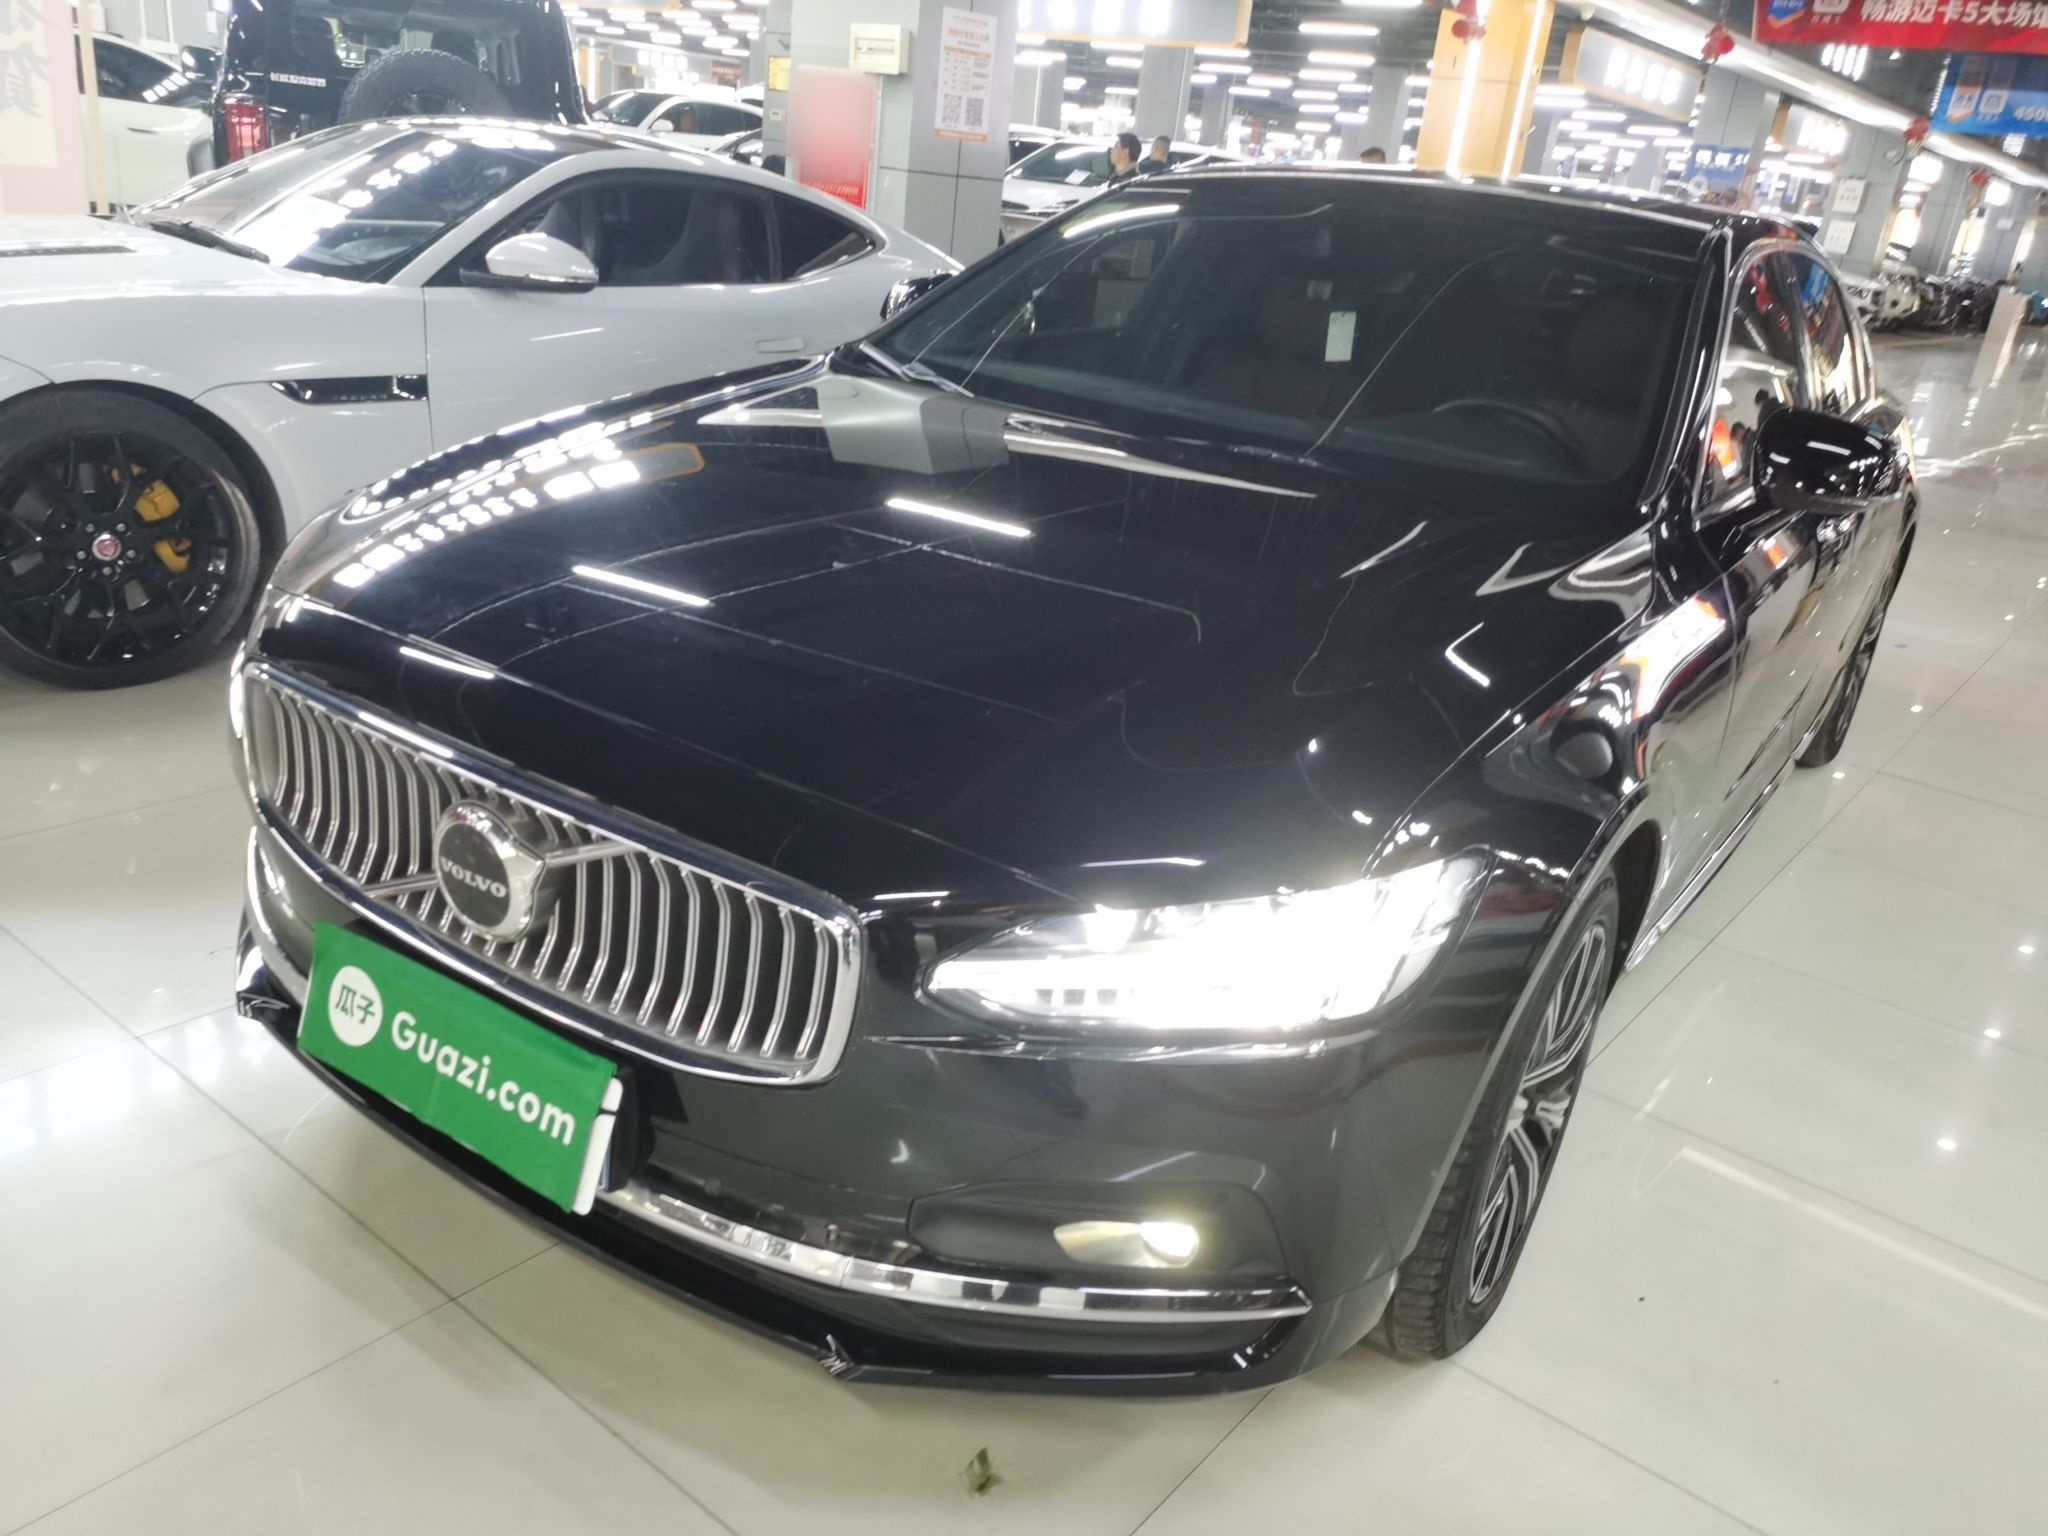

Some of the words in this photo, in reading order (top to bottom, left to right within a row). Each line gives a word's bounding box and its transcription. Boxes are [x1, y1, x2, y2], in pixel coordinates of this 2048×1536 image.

[440, 855, 507, 898] VOLVO
[336, 984, 376, 1025] 瓜子
[392, 1011, 576, 1146] Guazi.com
